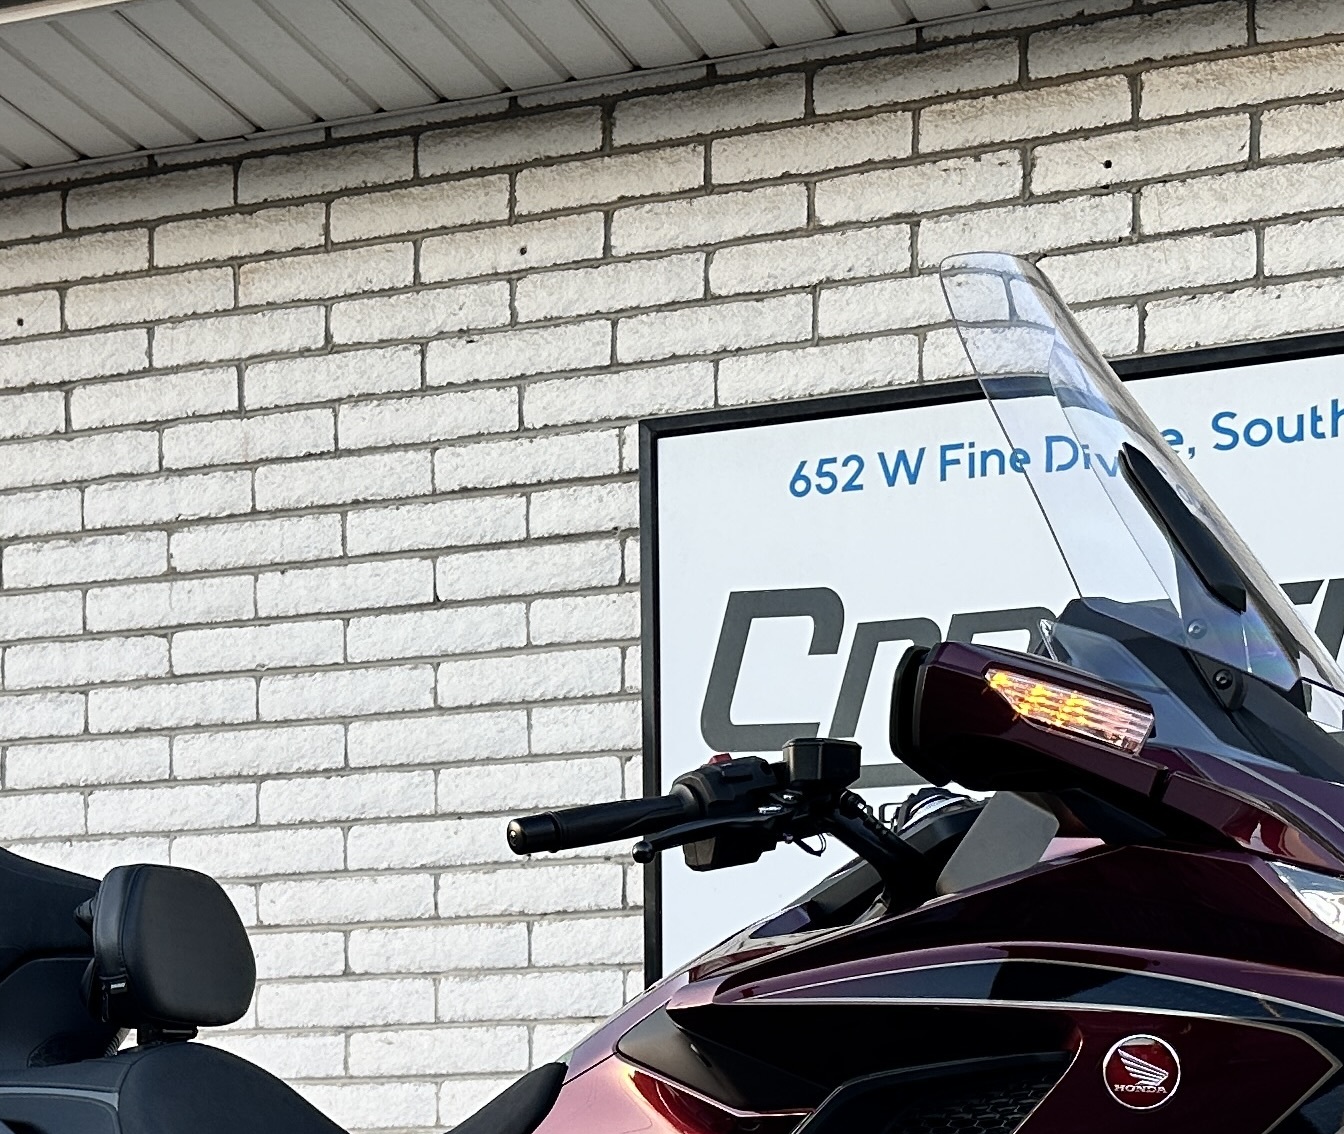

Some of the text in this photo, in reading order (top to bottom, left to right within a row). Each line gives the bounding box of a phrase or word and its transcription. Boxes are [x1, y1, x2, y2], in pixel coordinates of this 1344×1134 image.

[789, 454, 865, 498] 652
[877, 446, 926, 488] W
[940, 441, 1031, 482] Fine
[1113, 1084, 1168, 1094] HONDA
